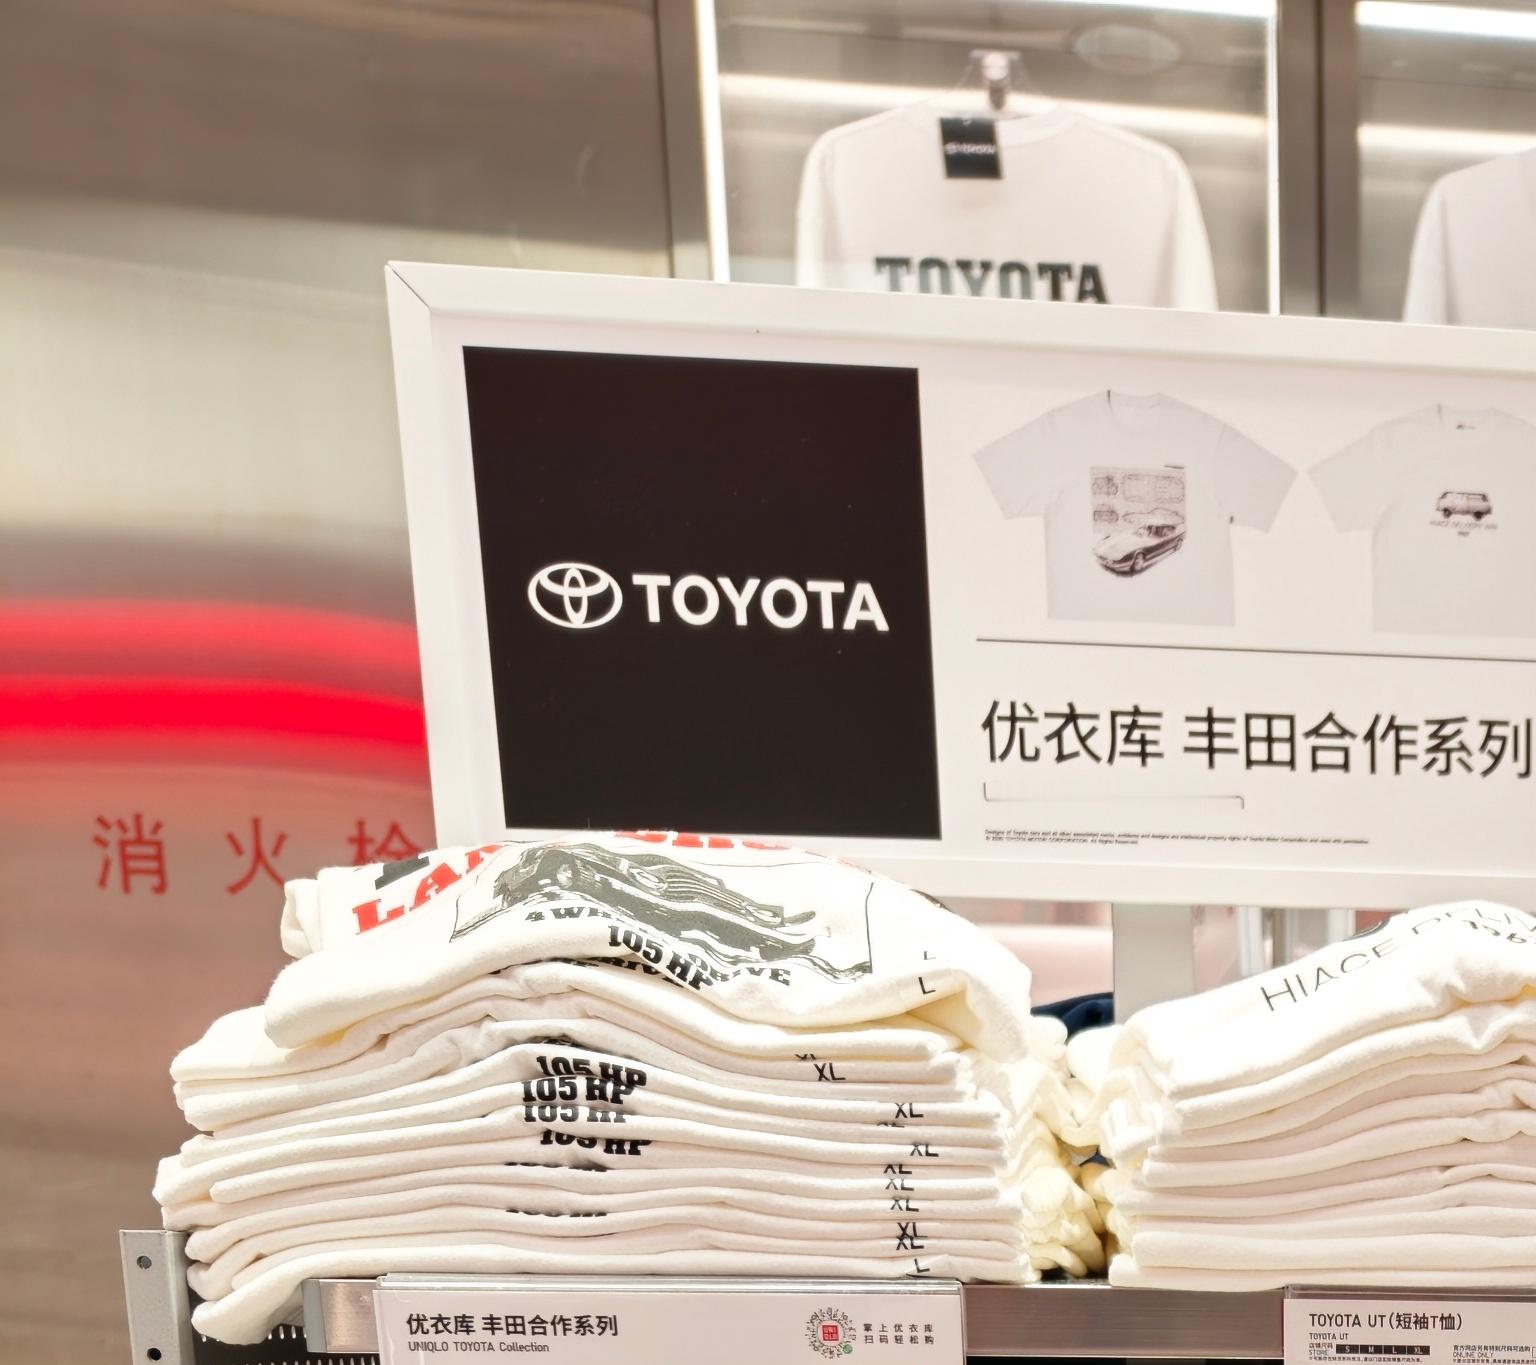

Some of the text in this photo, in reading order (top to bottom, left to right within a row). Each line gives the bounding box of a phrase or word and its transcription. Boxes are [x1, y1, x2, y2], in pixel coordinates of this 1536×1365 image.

[875, 256, 1111, 304] TOYOTA
[632, 572, 890, 633] TOYOTA
[981, 699, 1533, 779] 优衣库 丰田合作系列
[607, 924, 665, 969] 105
[917, 976, 936, 995] L
[1260, 937, 1400, 1011] HIACE
[536, 1056, 647, 1087] 105 HP
[814, 1062, 846, 1082] XL
[521, 1076, 635, 1105] 105 HP
[895, 1103, 924, 1119] XL
[914, 1258, 930, 1273] L
[406, 1313, 619, 1337] 优衣库 丰田合作系列
[1309, 1313, 1362, 1328] TOYOTA
[408, 1341, 550, 1353] UNIQLO TOYOTA Collection
[1309, 1332, 1349, 1341] TOYOTA UT
